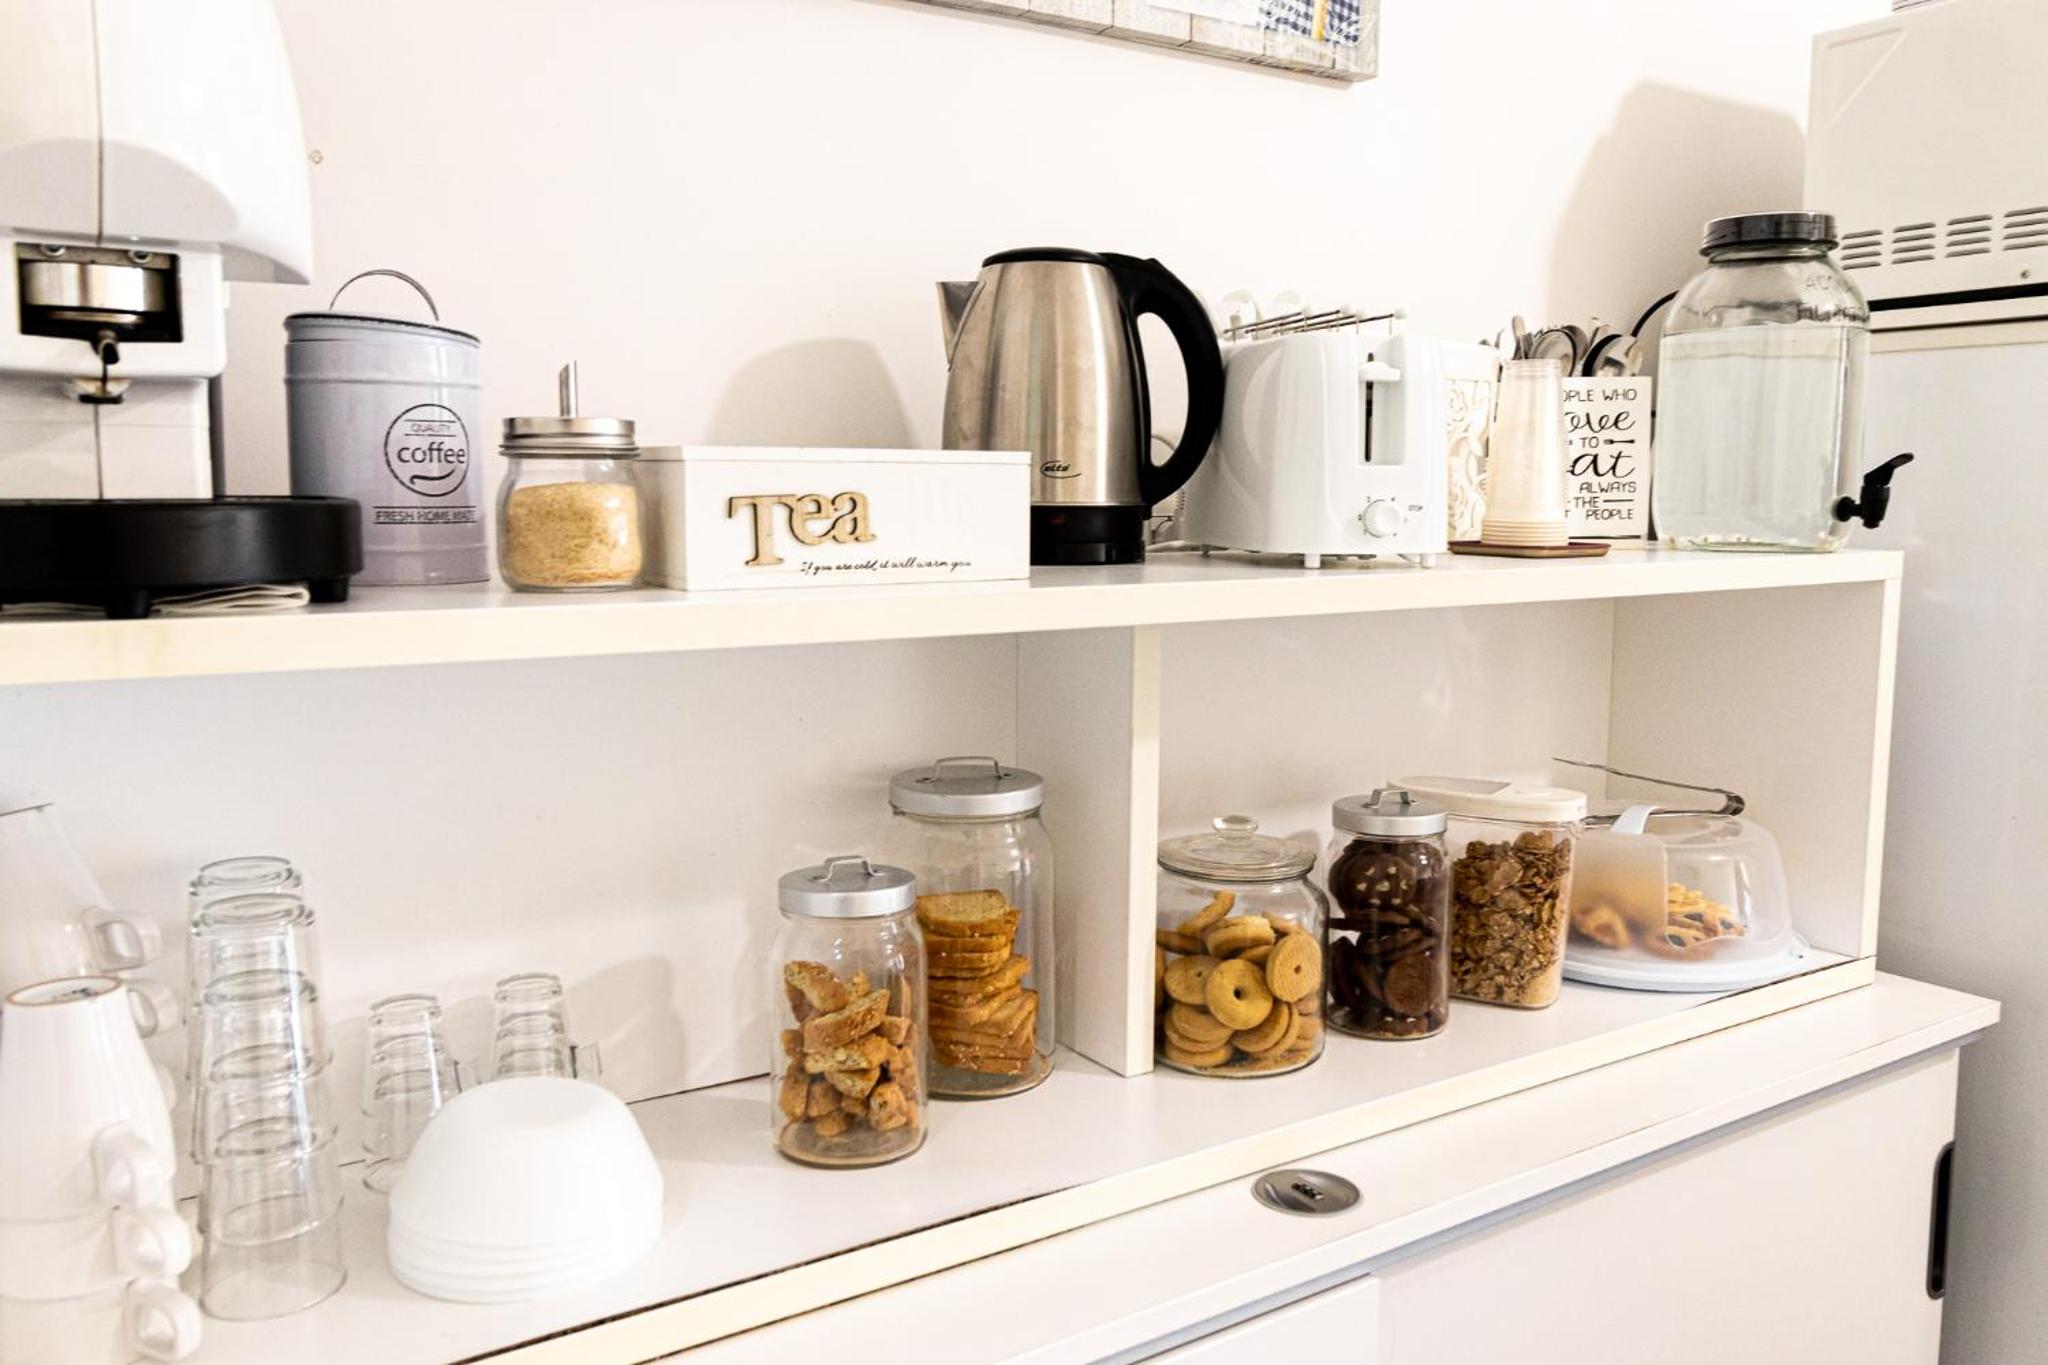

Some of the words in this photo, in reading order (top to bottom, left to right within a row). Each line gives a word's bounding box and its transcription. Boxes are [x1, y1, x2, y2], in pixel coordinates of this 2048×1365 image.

[1602, 388, 1638, 401] WHO
[1564, 411, 1636, 434] ove
[1579, 436, 1600, 449] TO
[397, 441, 466, 464] coffee
[1566, 450, 1635, 478] at
[1579, 481, 1637, 494] ALWAYS
[1573, 496, 1601, 508] THE
[375, 510, 415, 521] FRESH
[1585, 508, 1634, 520] PEOPLE
[726, 490, 877, 566] Tea
[813, 564, 832, 576] you
[891, 556, 918, 569] will
[947, 560, 972, 573] you
